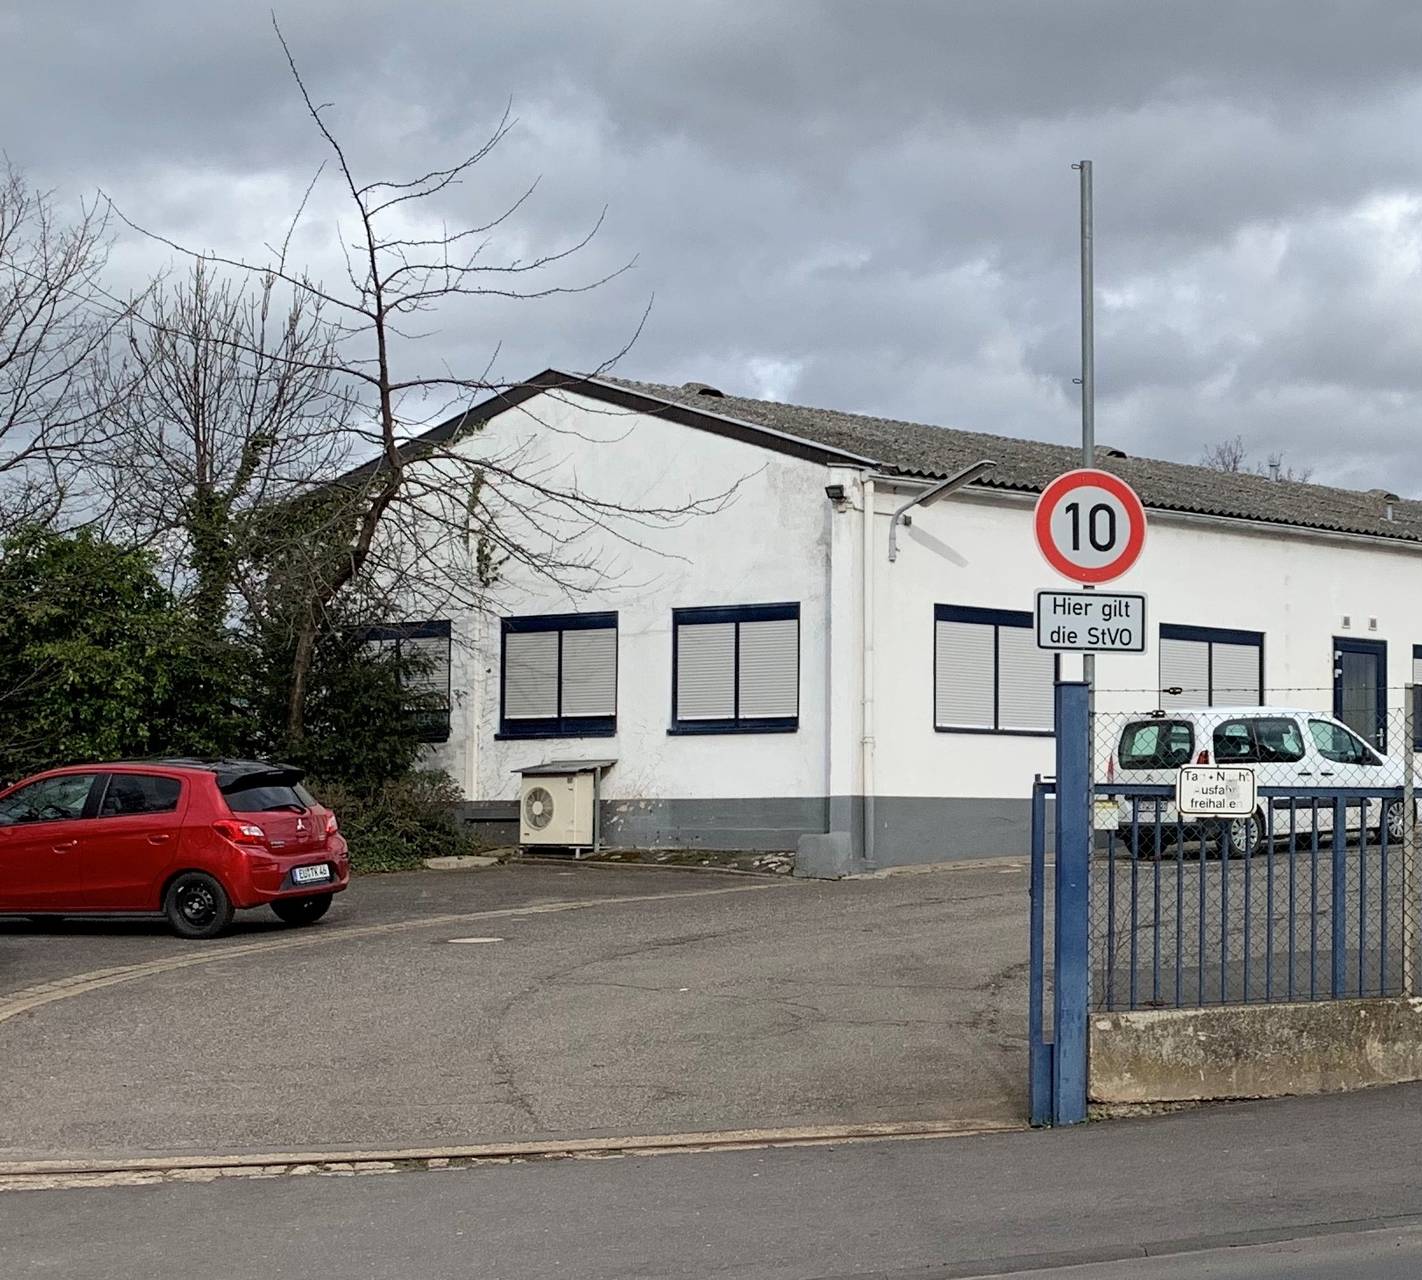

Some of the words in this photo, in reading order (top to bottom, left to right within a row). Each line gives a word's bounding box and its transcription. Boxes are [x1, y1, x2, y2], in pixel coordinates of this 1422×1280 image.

[1065, 502, 1116, 552] 10
[1053, 597, 1093, 616] Hier
[1102, 600, 1130, 621] gilt
[1050, 626, 1078, 644] die
[1087, 627, 1132, 646] StVO
